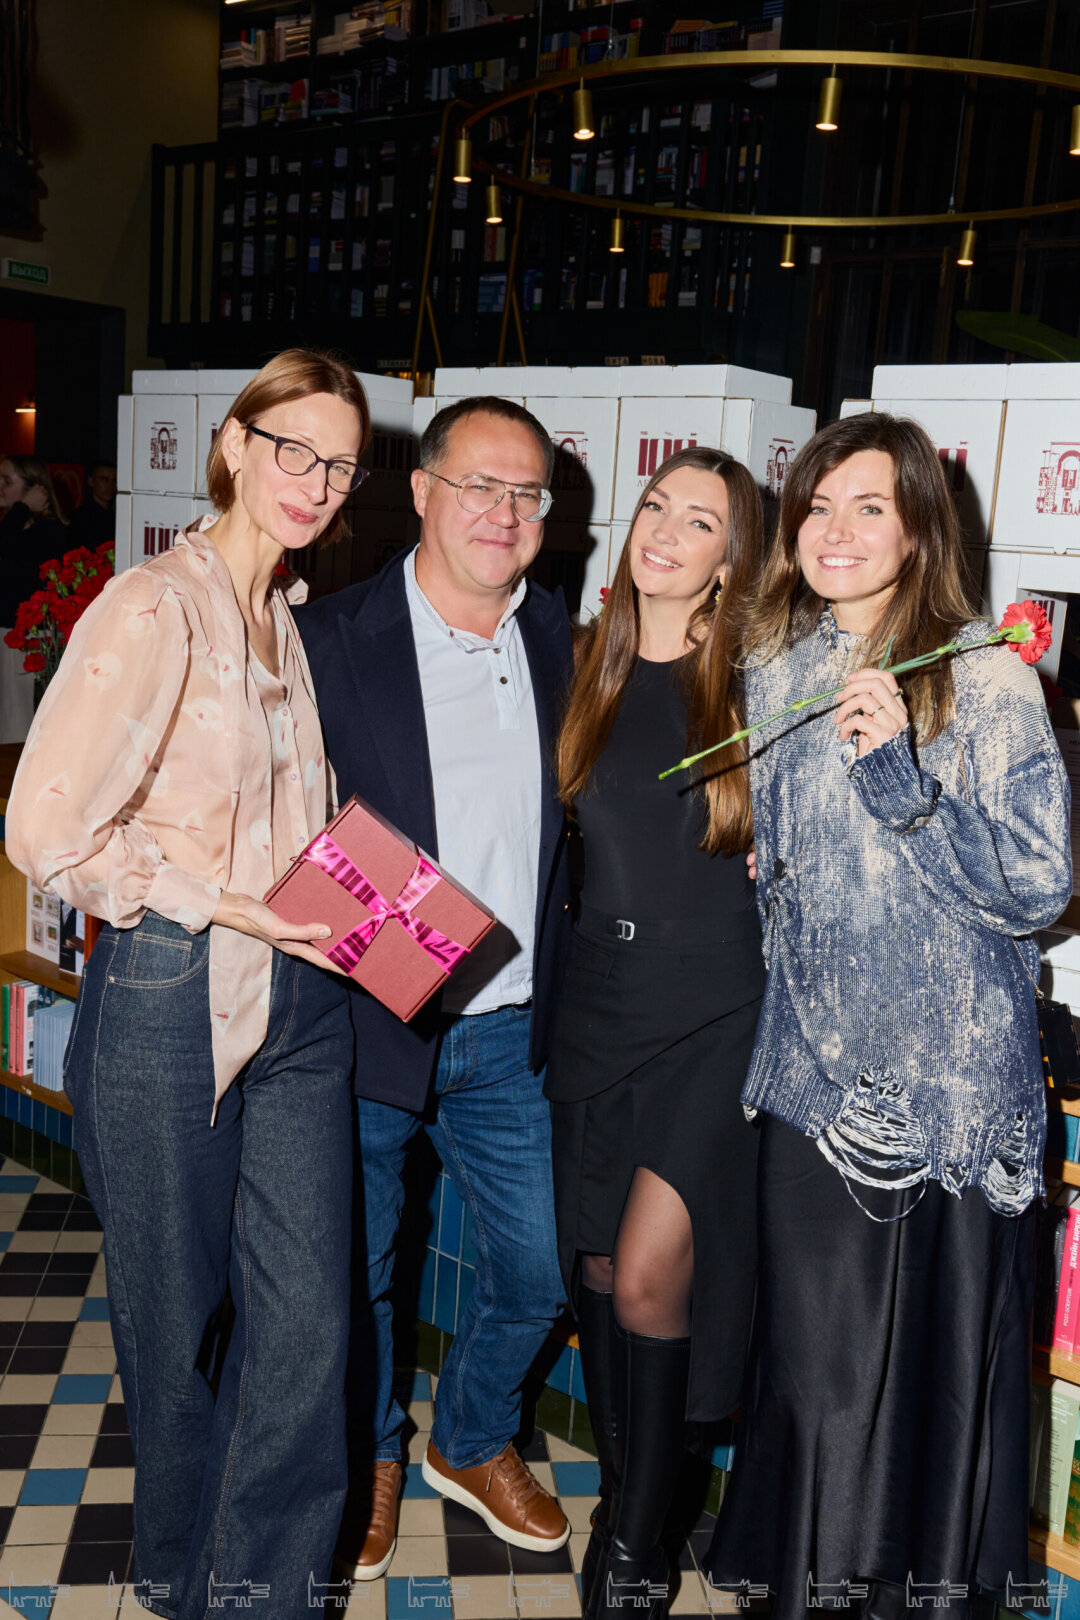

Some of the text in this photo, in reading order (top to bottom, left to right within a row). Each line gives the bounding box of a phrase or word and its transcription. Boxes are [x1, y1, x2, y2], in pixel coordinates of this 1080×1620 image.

[12, 263, 46, 281] ВЫХОД
[1072, 1214, 1080, 1242] БИРКИН
[1069, 1242, 1079, 1269] ДЖЕЙН
[1063, 1287, 1073, 1327] POST-SCRIPTUM
